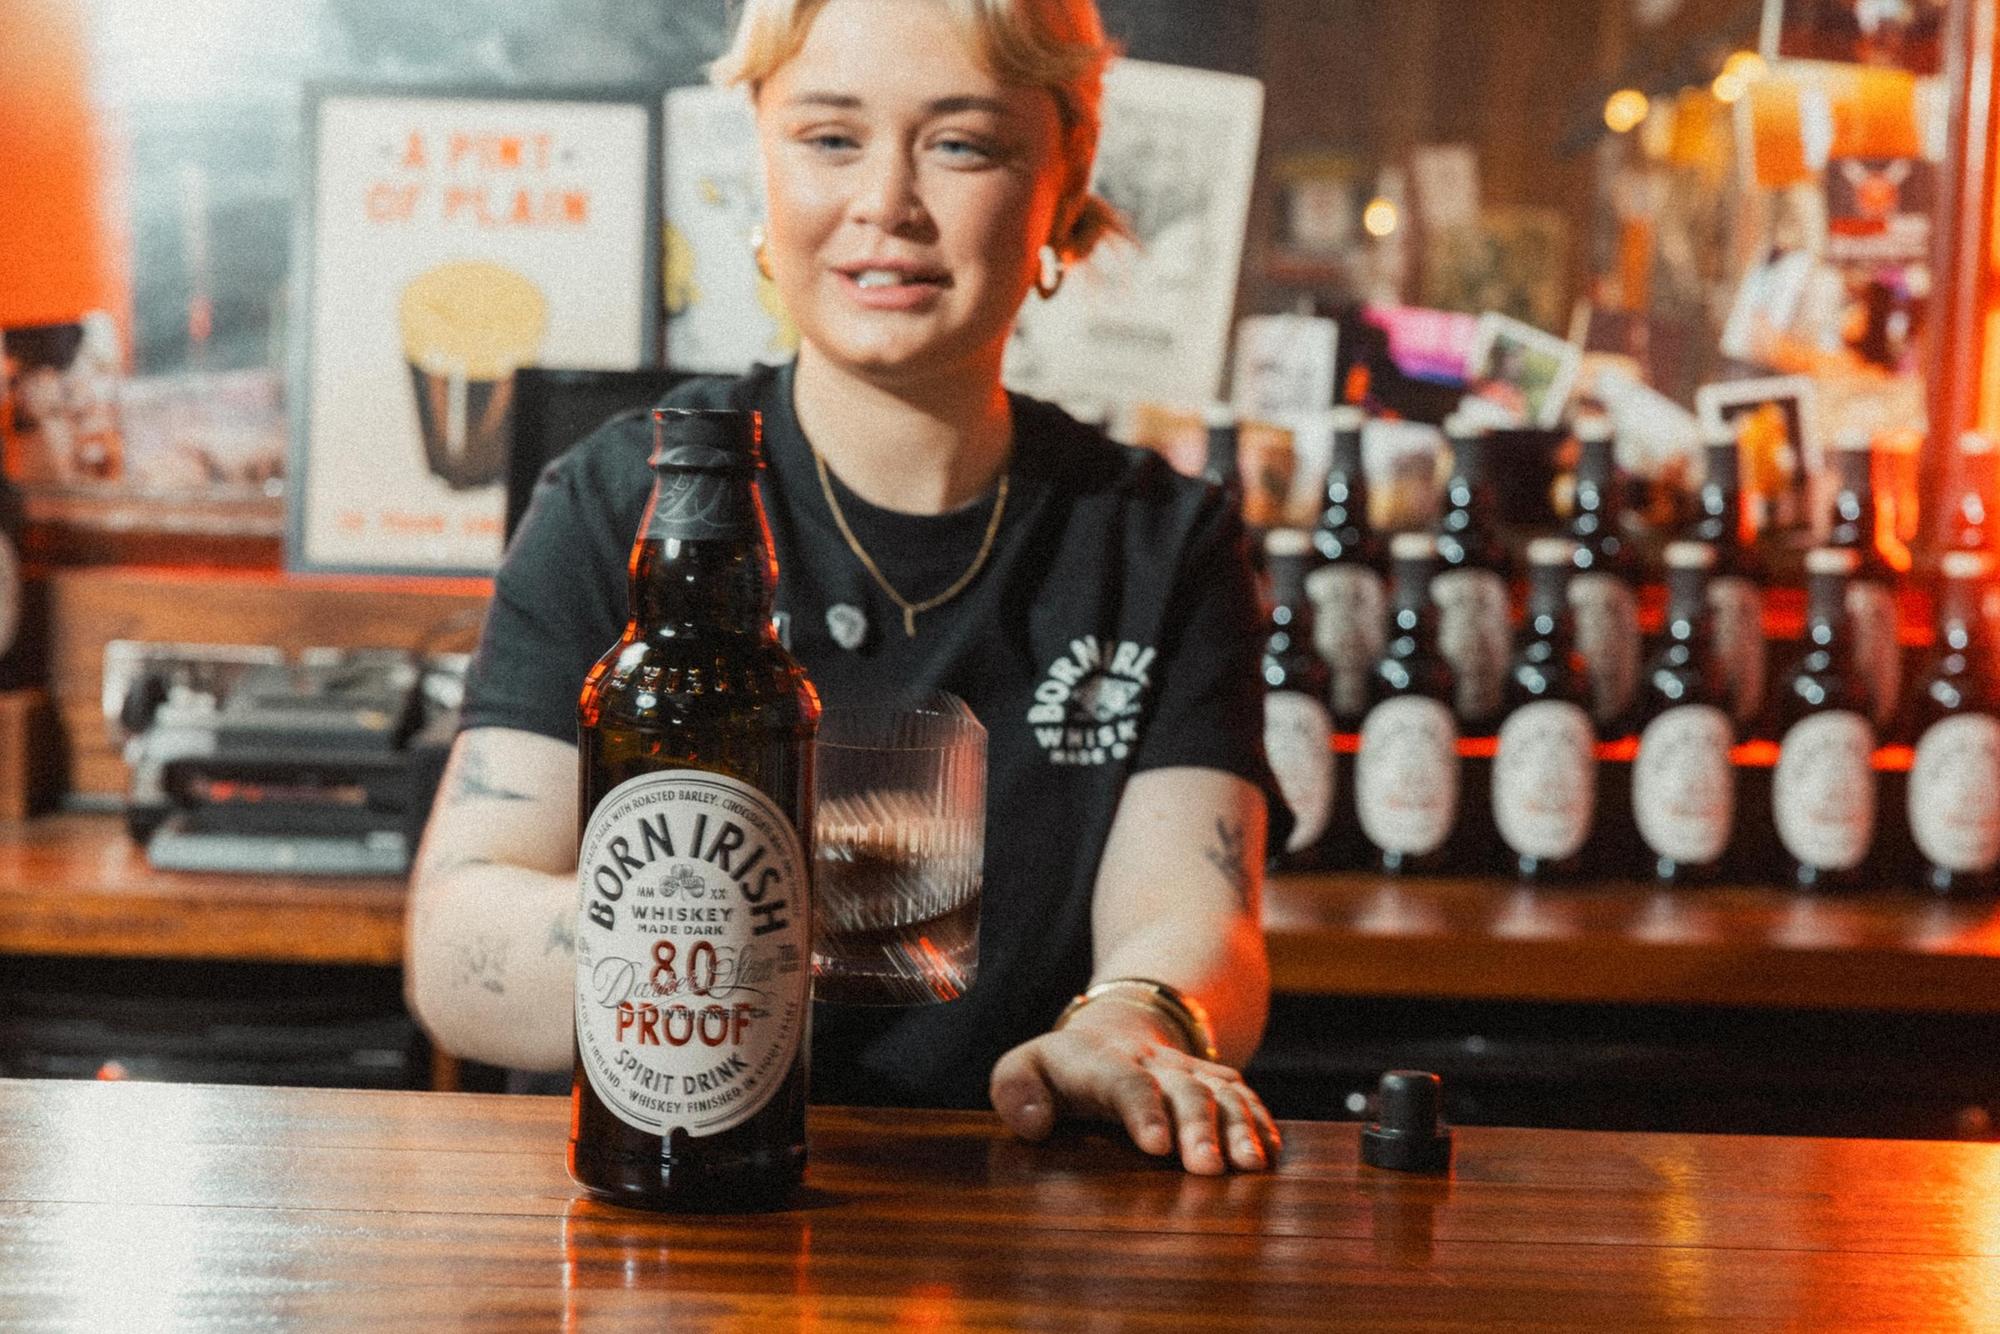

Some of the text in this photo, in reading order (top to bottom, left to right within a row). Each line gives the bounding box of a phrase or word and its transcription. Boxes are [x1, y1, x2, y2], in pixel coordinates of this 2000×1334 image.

[401, 131, 428, 171] A
[1026, 635, 1100, 723] BORN
[1034, 719, 1138, 748] WHISK
[612, 803, 632, 821] WITH
[632, 790, 676, 810] ROASTED
[588, 812, 676, 931] BORN
[689, 813, 789, 937] IRISH
[631, 904, 733, 922] WHISKEY
[637, 923, 723, 936] MADE DARK
[650, 939, 718, 997] 80
[615, 1000, 751, 1048] PROOF
[592, 1046, 621, 1088] IRELAND
[629, 1090, 682, 1114] WHISKEY
[686, 1086, 742, 1113] FINISHED
[614, 1048, 750, 1096] SPIRIT DRINK
